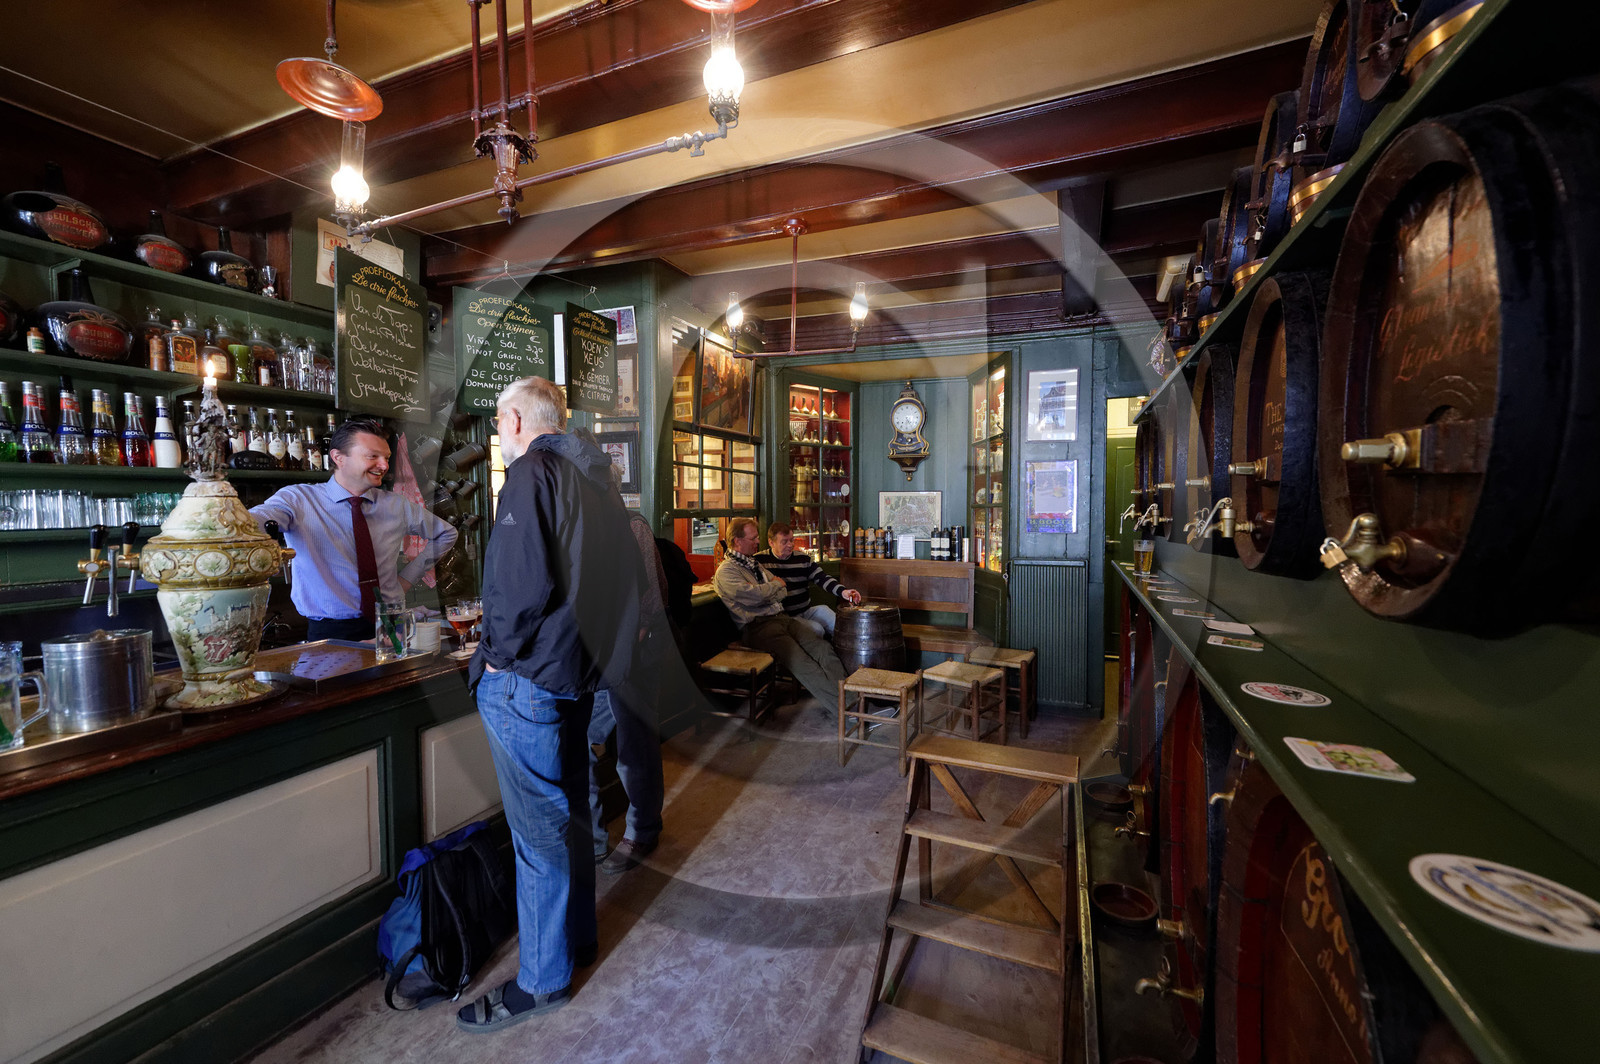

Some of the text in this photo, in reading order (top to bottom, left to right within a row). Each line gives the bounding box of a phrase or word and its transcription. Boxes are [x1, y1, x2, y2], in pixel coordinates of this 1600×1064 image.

[352, 272, 368, 287] De
[369, 282, 386, 294] drie
[360, 266, 408, 297] PROEFLOKAAL
[468, 301, 486, 314] De
[487, 308, 503, 317] drie
[478, 297, 531, 315] PROEFLOKAAL
[477, 317, 502, 329] Open
[500, 339, 518, 350] SOL
[581, 338, 609, 357] KOEN'S
[583, 352, 605, 369] KEUS
[471, 369, 486, 379] DE
[587, 372, 611, 386] GEMBER
